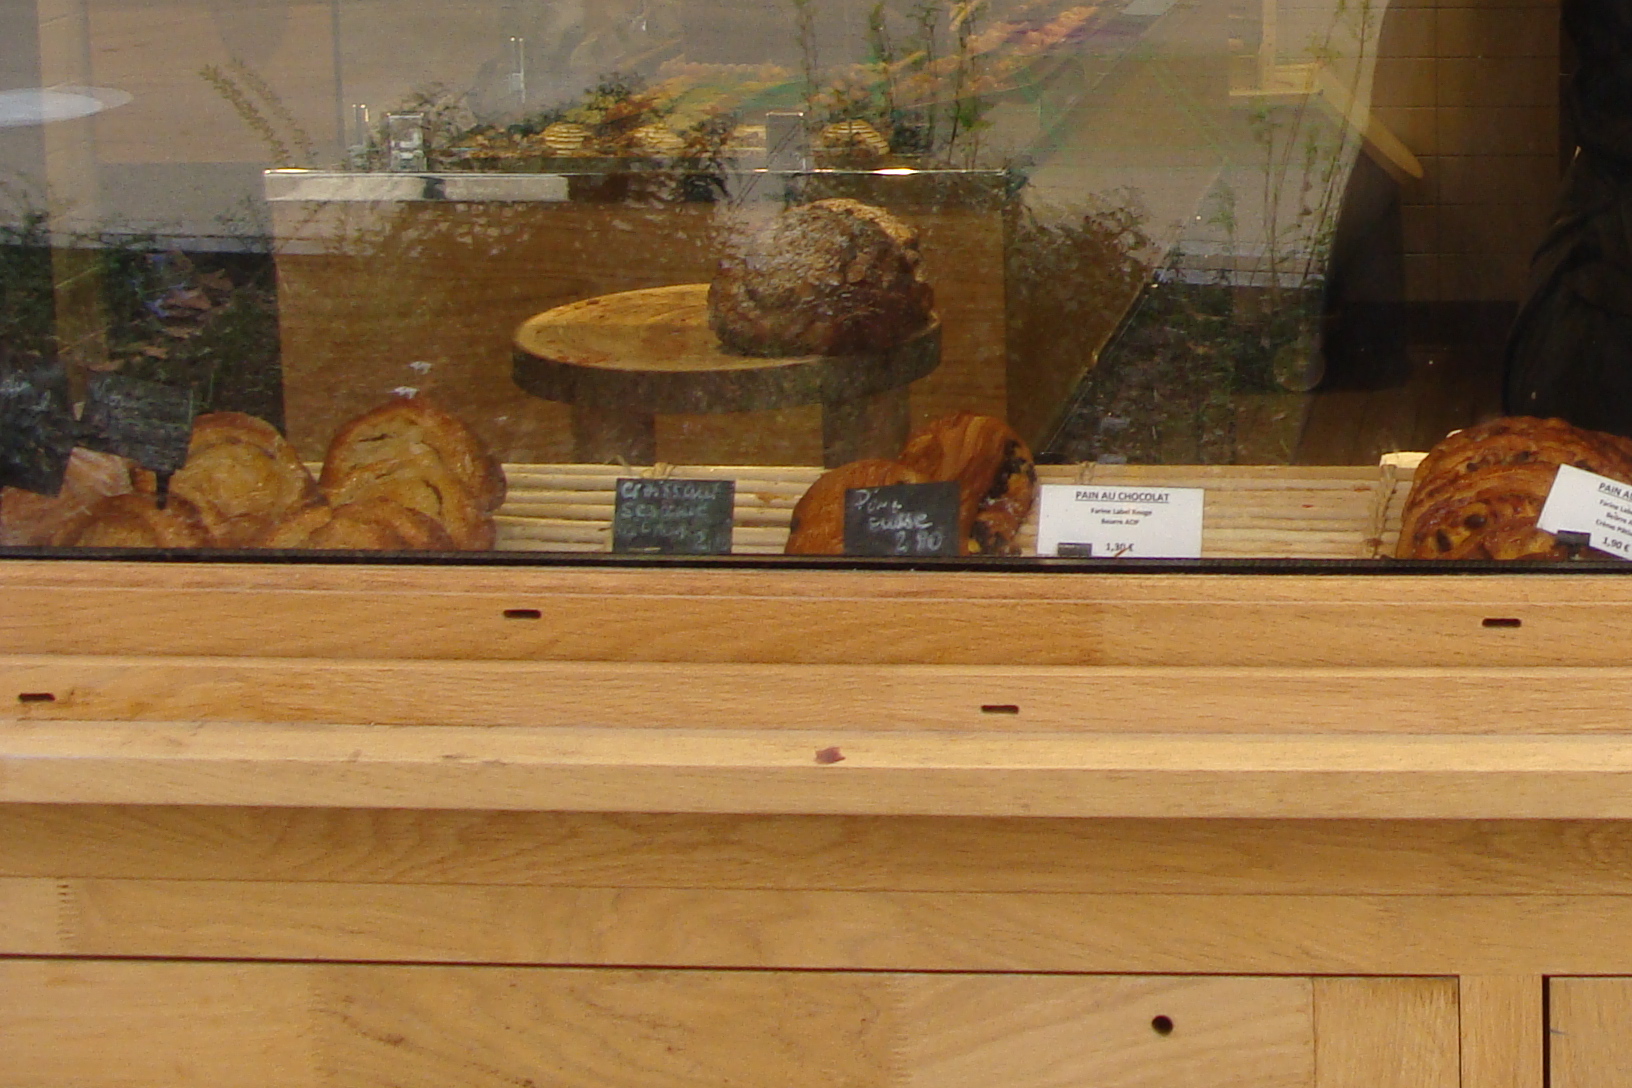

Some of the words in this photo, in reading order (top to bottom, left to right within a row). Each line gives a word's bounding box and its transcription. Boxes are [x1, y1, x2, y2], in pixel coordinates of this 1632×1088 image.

[1075, 490, 1099, 500] PAIN
[1101, 491, 1116, 501] AU
[1118, 491, 1170, 502] CHOCOLAT
[1599, 482, 1622, 498] PAIN
[1600, 499, 1619, 510] Farine
[1595, 519, 1616, 531] Crème
[1106, 543, 1125, 552] 1,30
[1128, 543, 1135, 552] €
[1602, 536, 1622, 549] 1,90
[1624, 543, 1631, 553] €
